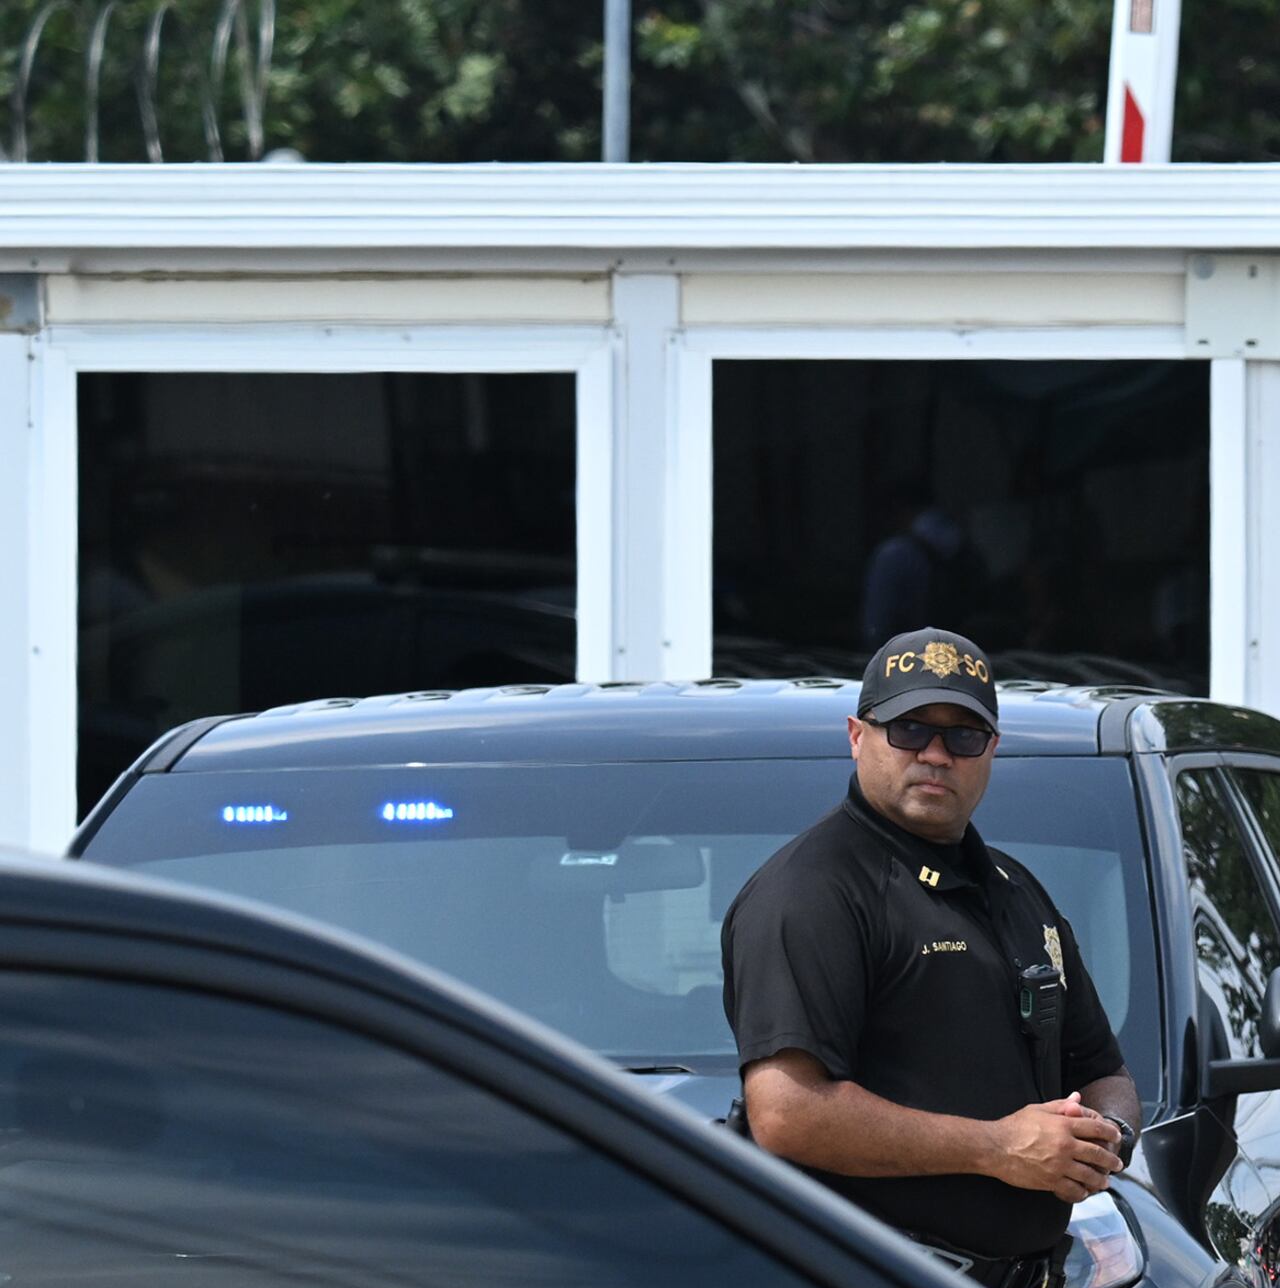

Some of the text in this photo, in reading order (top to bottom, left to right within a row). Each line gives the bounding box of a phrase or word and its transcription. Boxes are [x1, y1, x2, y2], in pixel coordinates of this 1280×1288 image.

[885, 651, 989, 683] FC SO
[932, 940, 967, 951] SANTIAGO
